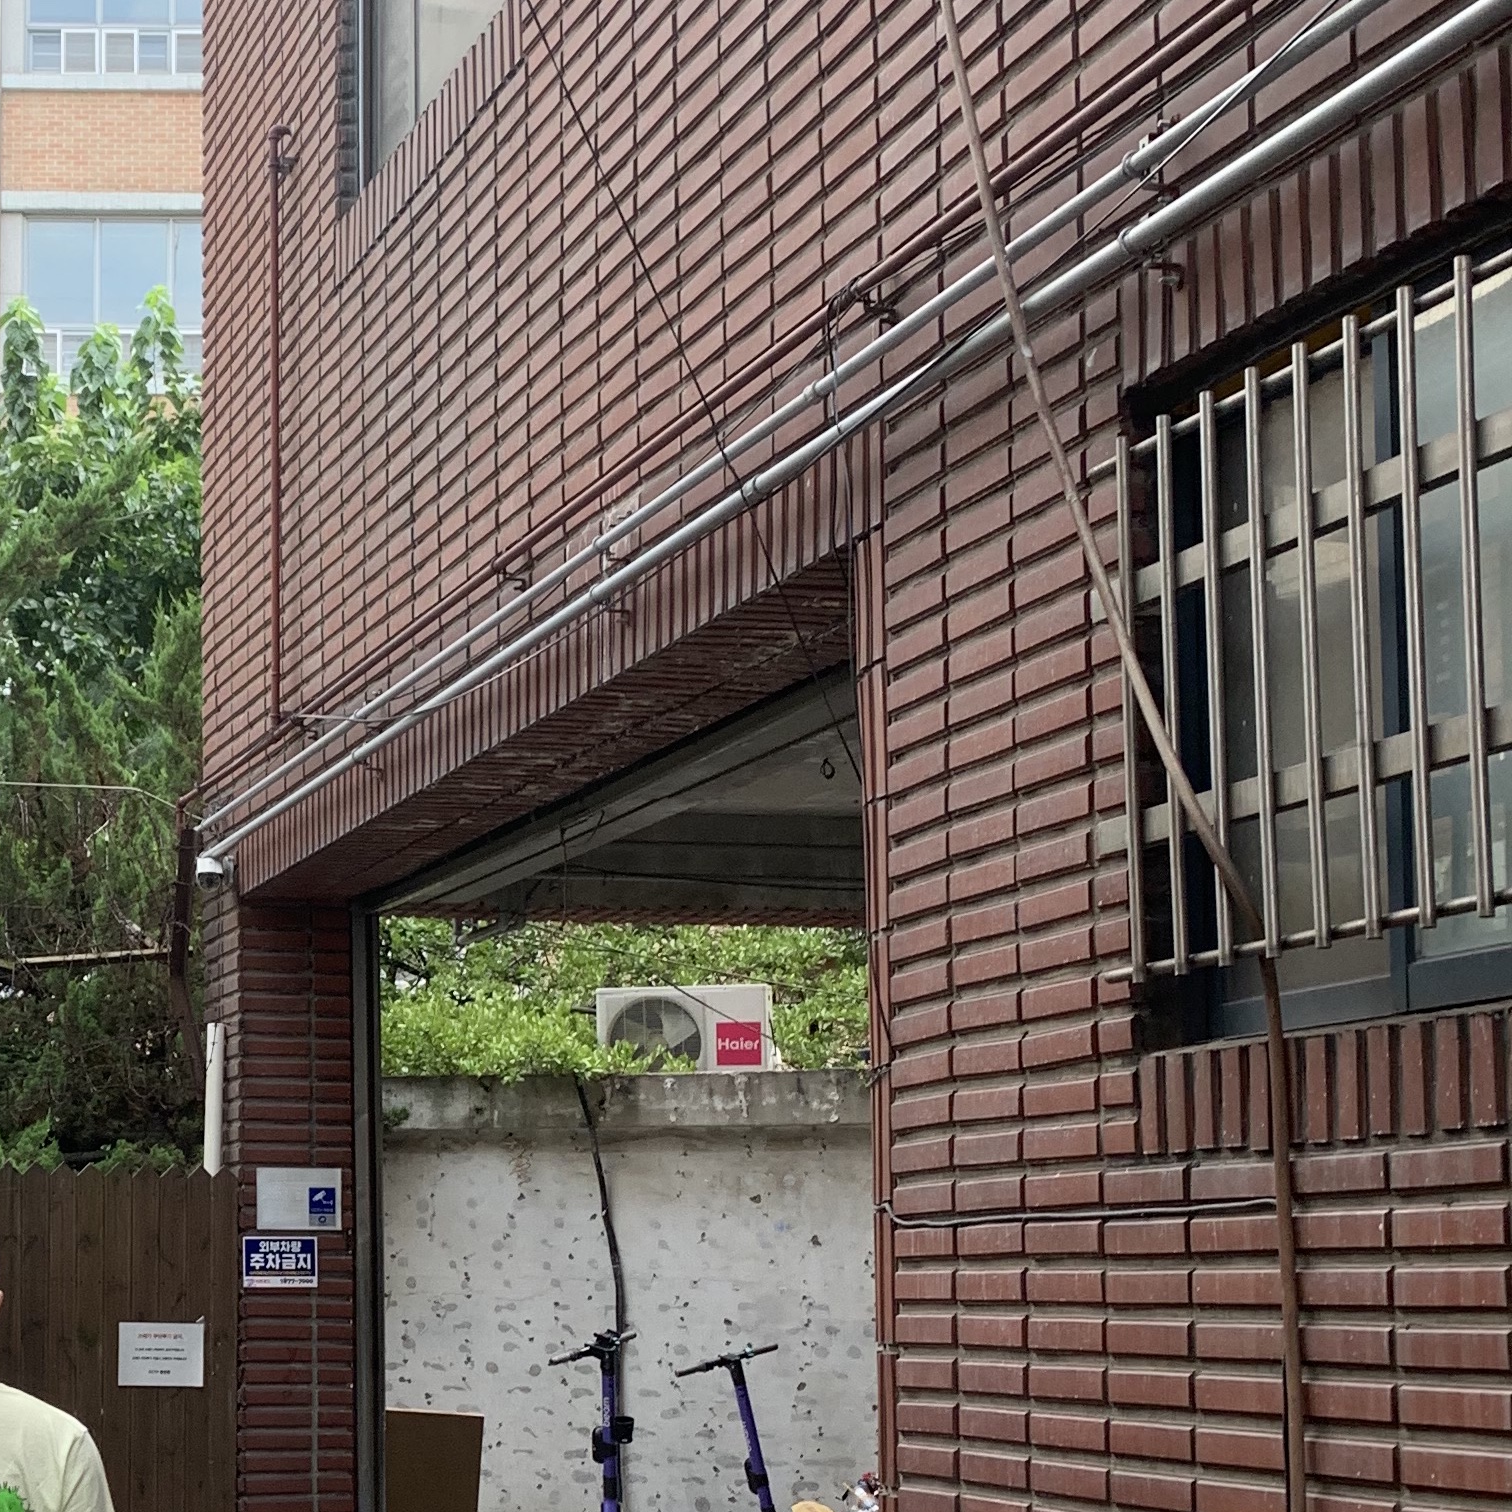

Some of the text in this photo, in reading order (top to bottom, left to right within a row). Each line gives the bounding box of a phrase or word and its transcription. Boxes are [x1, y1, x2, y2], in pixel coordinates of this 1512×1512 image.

[717, 1037, 760, 1051] Haier
[258, 1241, 302, 1252] 외부차량
[249, 1253, 312, 1270] 주차금지
[601, 1396, 611, 1428] beam
